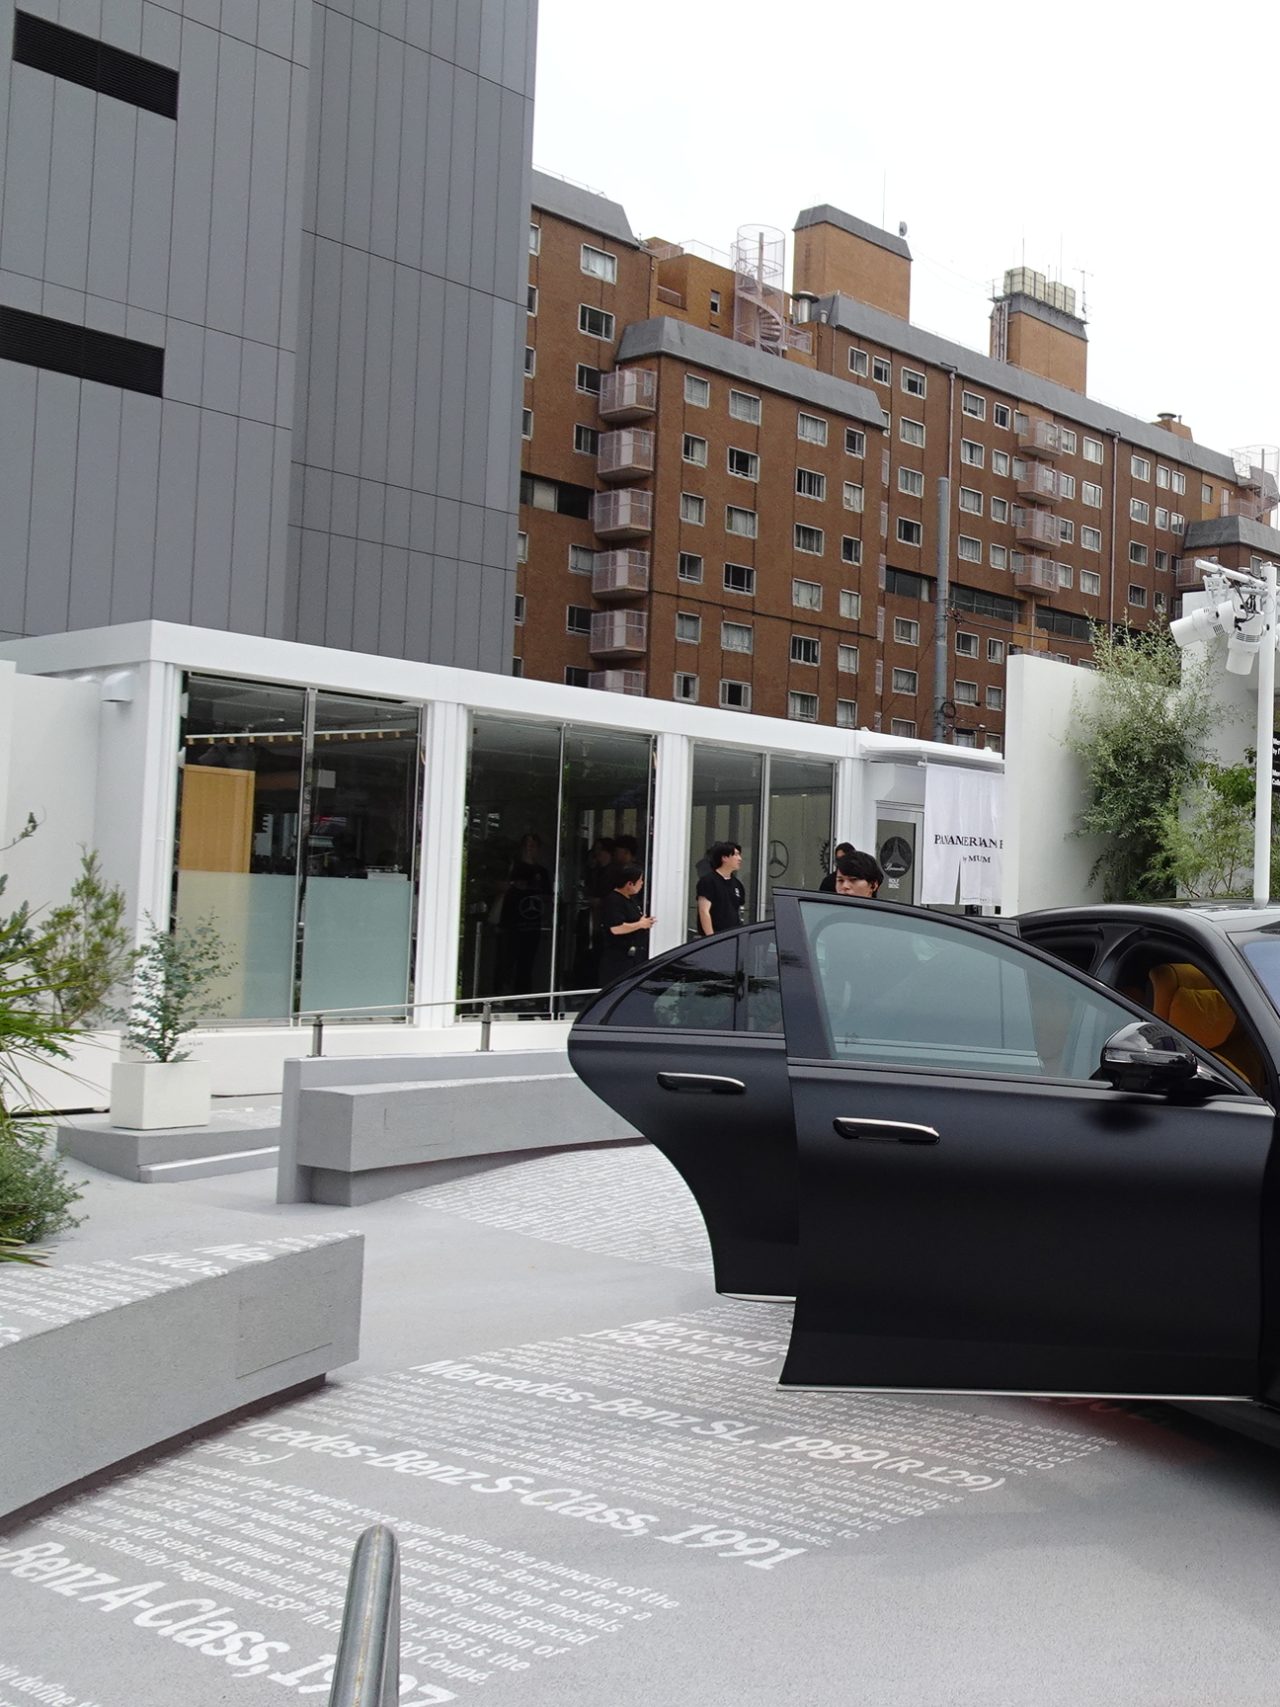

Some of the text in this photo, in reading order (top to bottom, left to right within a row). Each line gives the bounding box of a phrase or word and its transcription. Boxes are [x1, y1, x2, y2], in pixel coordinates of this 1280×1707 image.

[581, 1328, 682, 1349] 1982
[621, 1319, 789, 1354] Mercede
[408, 1360, 704, 1428] Mercedes-Benz
[691, 1420, 760, 1446] SL,
[759, 1434, 890, 1464] 1989
[195, 1442, 297, 1467] eries)
[811, 1464, 856, 1477] with
[859, 1474, 962, 1502] numerous
[919, 1447, 984, 1464] touring
[985, 1462, 1027, 1475] cars.
[1011, 1457, 1054, 1469] EVO
[235, 1421, 808, 1571] rcedes-Benz S-Class, 1991
[559, 1450, 595, 1461] this
[595, 1459, 659, 1477] results
[711, 1487, 811, 1513] extremely
[813, 1511, 881, 1530] stable
[759, 1464, 813, 1478] which
[814, 1477, 938, 1509] automatically
[762, 1487, 807, 1498] roof
[805, 1496, 863, 1512] frame
[863, 1511, 905, 1523] and
[799, 1482, 924, 1516] Together with
[239, 1490, 275, 1501] For
[271, 1499, 305, 1511] the
[304, 1508, 350, 1526] first
[399, 1538, 558, 1589] Mercedes-Benz
[559, 1589, 632, 1613] offers
[632, 1612, 652, 1620] a
[304, 1494, 357, 1510] series
[393, 1521, 444, 1536] again
[441, 1534, 501, 1553] define
[500, 1550, 535, 1563] the
[528, 1561, 617, 1588] pinnacle
[616, 1586, 650, 1596] of
[641, 1592, 679, 1608] the
[691, 1507, 732, 1518] and
[729, 1517, 830, 1546] sportiness.
[770, 1512, 834, 1532] thanks
[836, 1529, 859, 1538] to
[93, 1498, 570, 1657] Mercedes-Benz continues the tradition of
[124, 1526, 166, 1538] 140
[155, 1537, 211, 1559] series.
[210, 1556, 234, 1565] A
[225, 1561, 313, 1593] technical
[411, 1627, 472, 1648] 1995
[463, 1643, 490, 1657] is
[488, 1652, 529, 1670] the
[192, 1508, 235, 1526] With
[231, 1522, 301, 1548] Pullman
[416, 1582, 481, 1602] 1996)
[473, 1603, 522, 1619] and
[513, 1616, 597, 1644] special
[231, 1506, 326, 1539] production,
[399, 1558, 448, 1574] used
[446, 1570, 472, 1582] in
[469, 1578, 506, 1593] the
[504, 1590, 544, 1606] top
[542, 1603, 622, 1631] models
[0, 1541, 121, 1597] Benz
[78, 1581, 291, 1678] A-Class,
[101, 1537, 168, 1565] Stability
[165, 1561, 262, 1598] Programme
[418, 1653, 488, 1684] Coupé.
